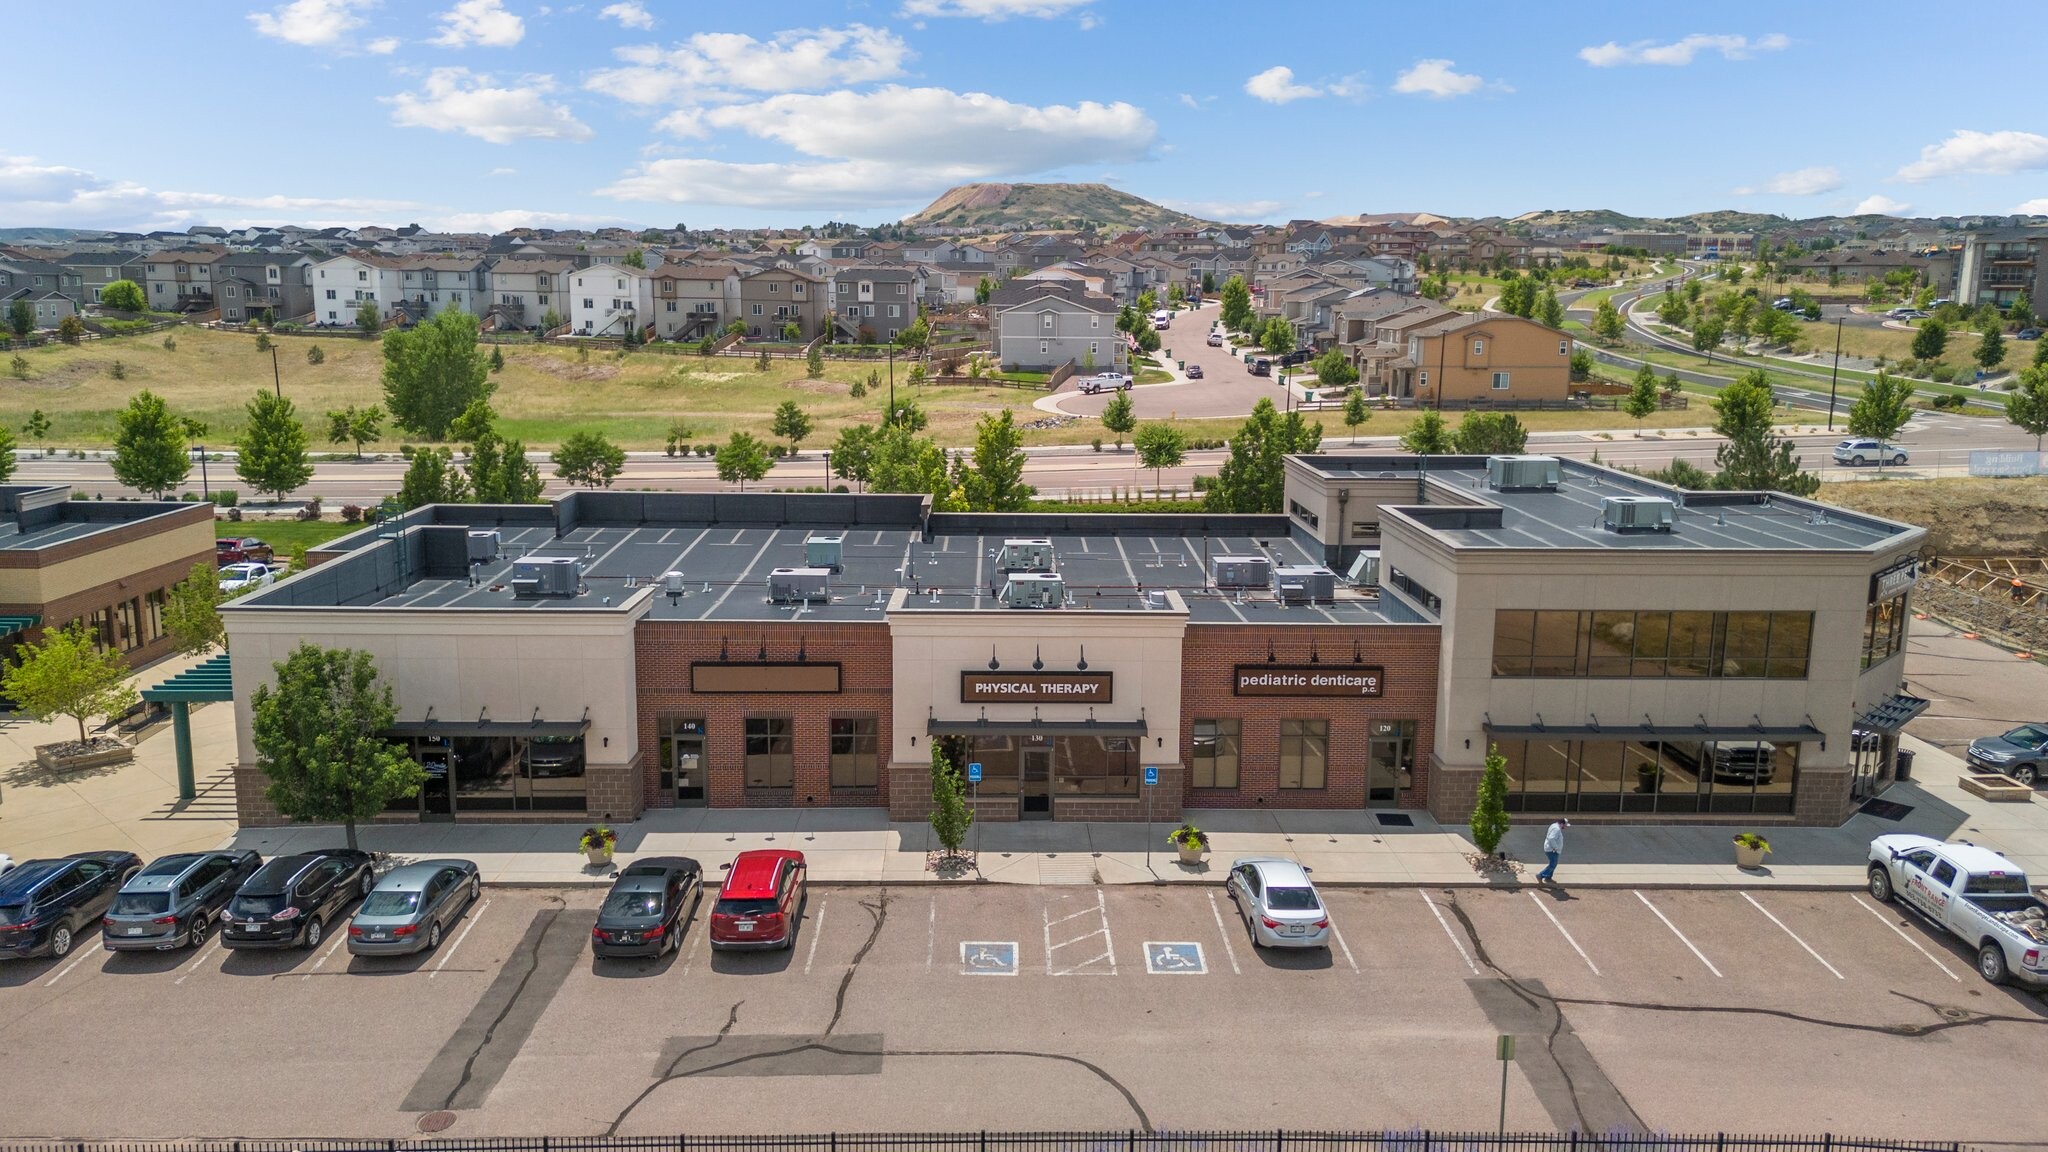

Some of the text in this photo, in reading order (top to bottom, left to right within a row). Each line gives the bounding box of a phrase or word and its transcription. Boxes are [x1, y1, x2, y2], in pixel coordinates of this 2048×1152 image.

[1240, 674, 1377, 688] pediatric denticare
[975, 683, 1099, 694] PHYSICAL THERAPY
[684, 722, 696, 730] 140
[1910, 878, 1928, 893] FRONT
[1927, 889, 1946, 908] RANGE
